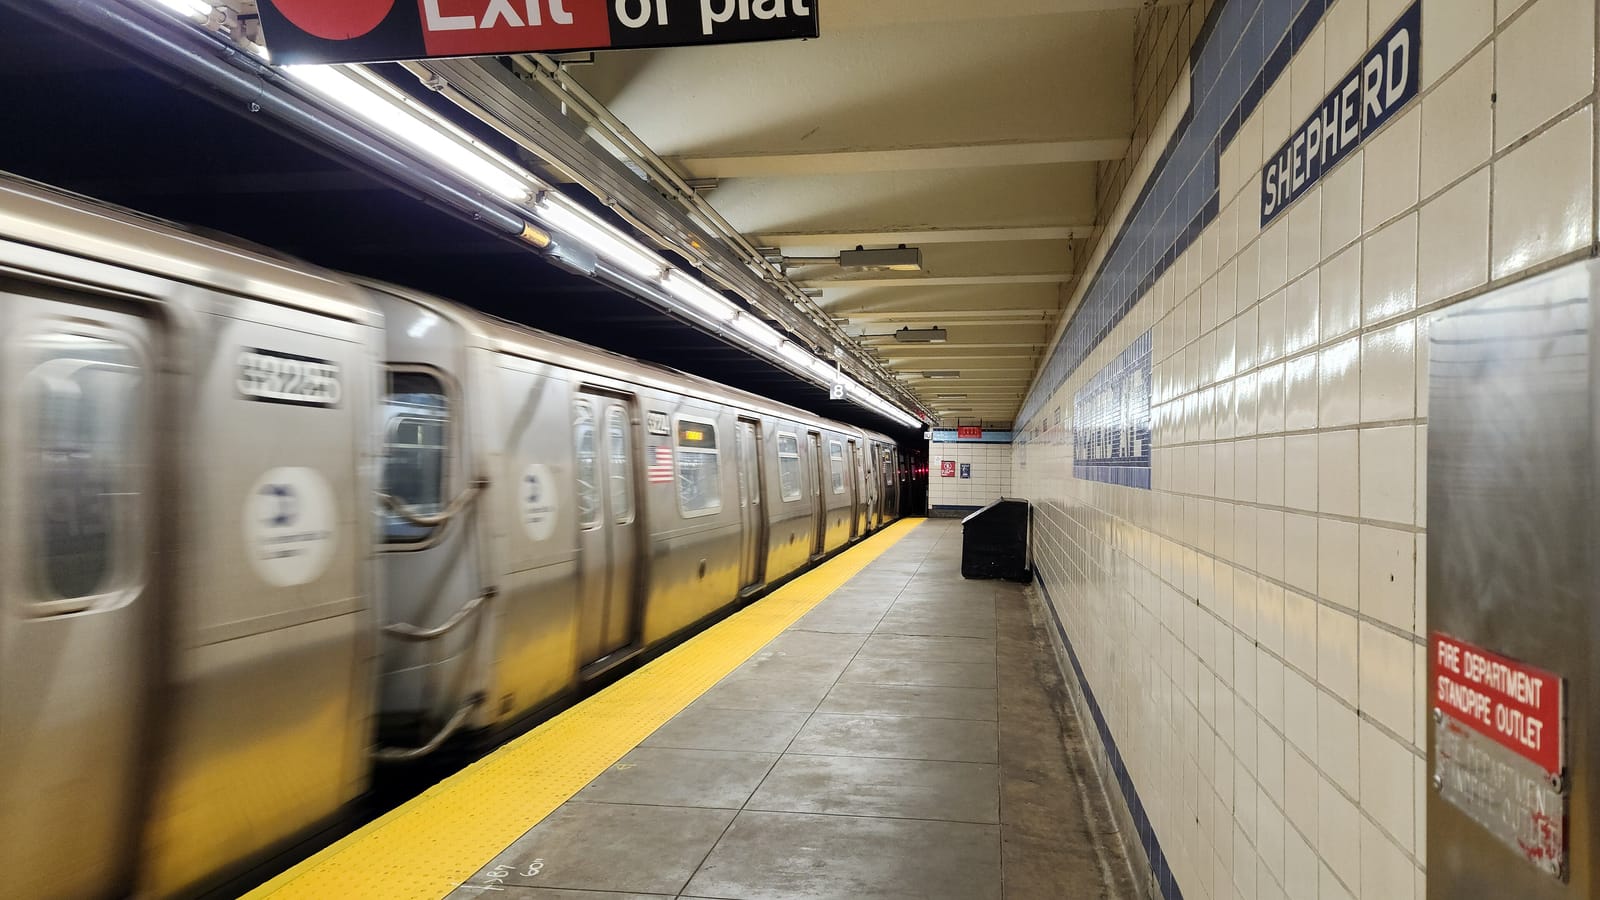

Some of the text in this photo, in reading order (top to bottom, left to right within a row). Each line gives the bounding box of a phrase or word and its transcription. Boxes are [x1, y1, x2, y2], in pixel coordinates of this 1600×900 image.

[1264, 28, 1410, 215] SHEPHERD
[833, 384, 844, 398] 8
[1438, 640, 1543, 709] FIRE DEPARTMENT
[1438, 675, 1543, 751] STANDPIPE OUTLET
